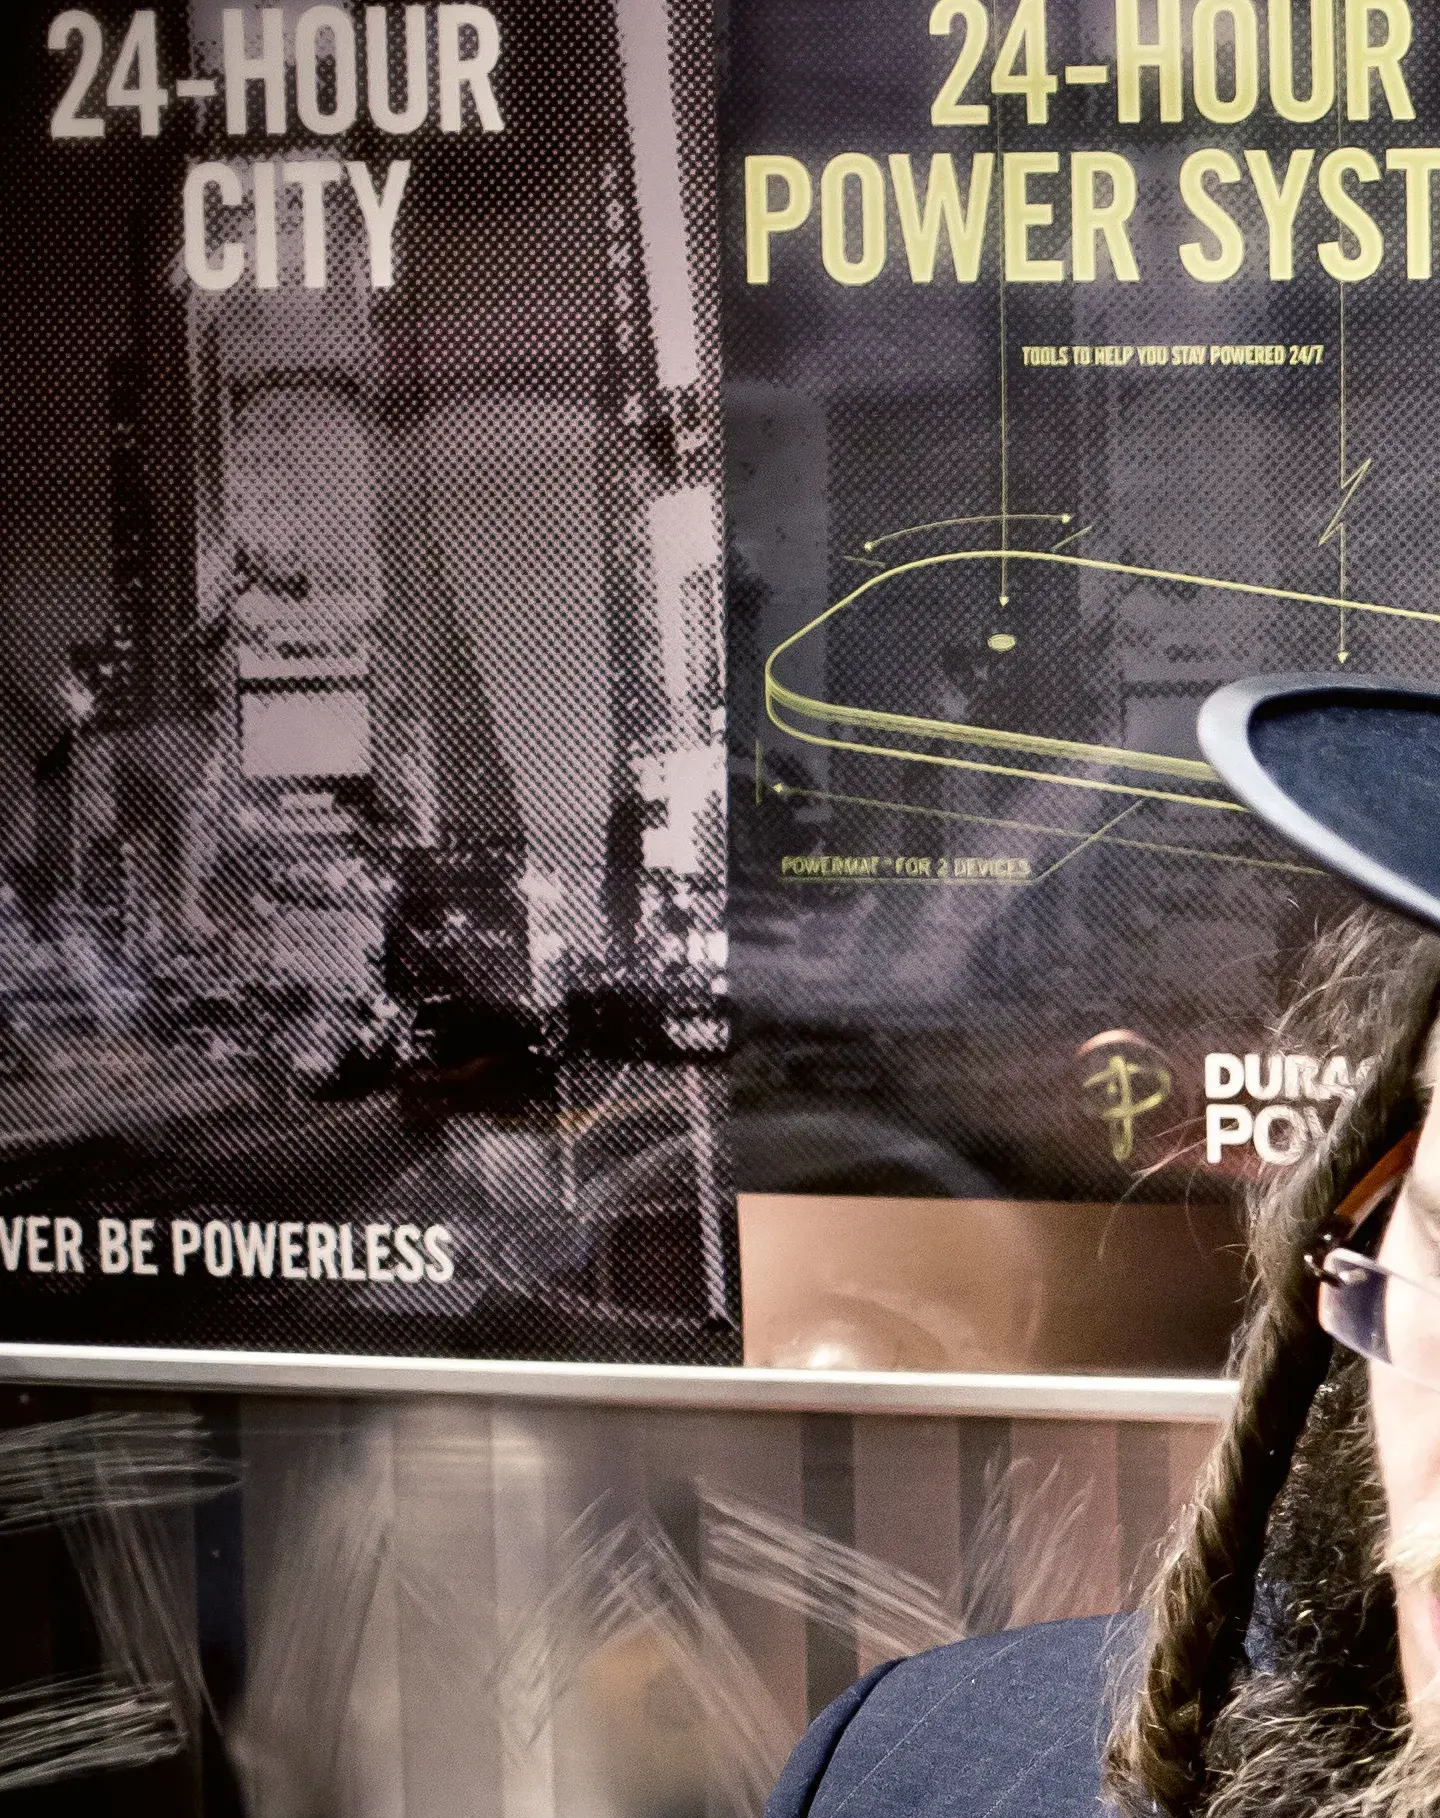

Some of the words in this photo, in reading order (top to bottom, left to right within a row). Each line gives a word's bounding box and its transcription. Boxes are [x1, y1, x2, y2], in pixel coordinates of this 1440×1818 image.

[47, 4, 505, 141] 24-HOUR
[929, 0, 1417, 127] 24-HOUR
[182, 158, 412, 291] CITY
[744, 149, 1140, 286] POWER
[1022, 345, 1068, 366] TOOLS
[1072, 345, 1092, 366] TO
[1094, 345, 1134, 366] HELP
[1137, 345, 1169, 366] YOU
[1171, 344, 1207, 365] STAY
[1210, 344, 1287, 365] POWERED
[1289, 344, 1325, 365] 24/7
[895, 856, 931, 876] FOR
[936, 857, 949, 877] 2
[953, 857, 1033, 878] DEVICES
[99, 1218, 159, 1276] BE
[171, 1218, 456, 1283] POWERLESS
